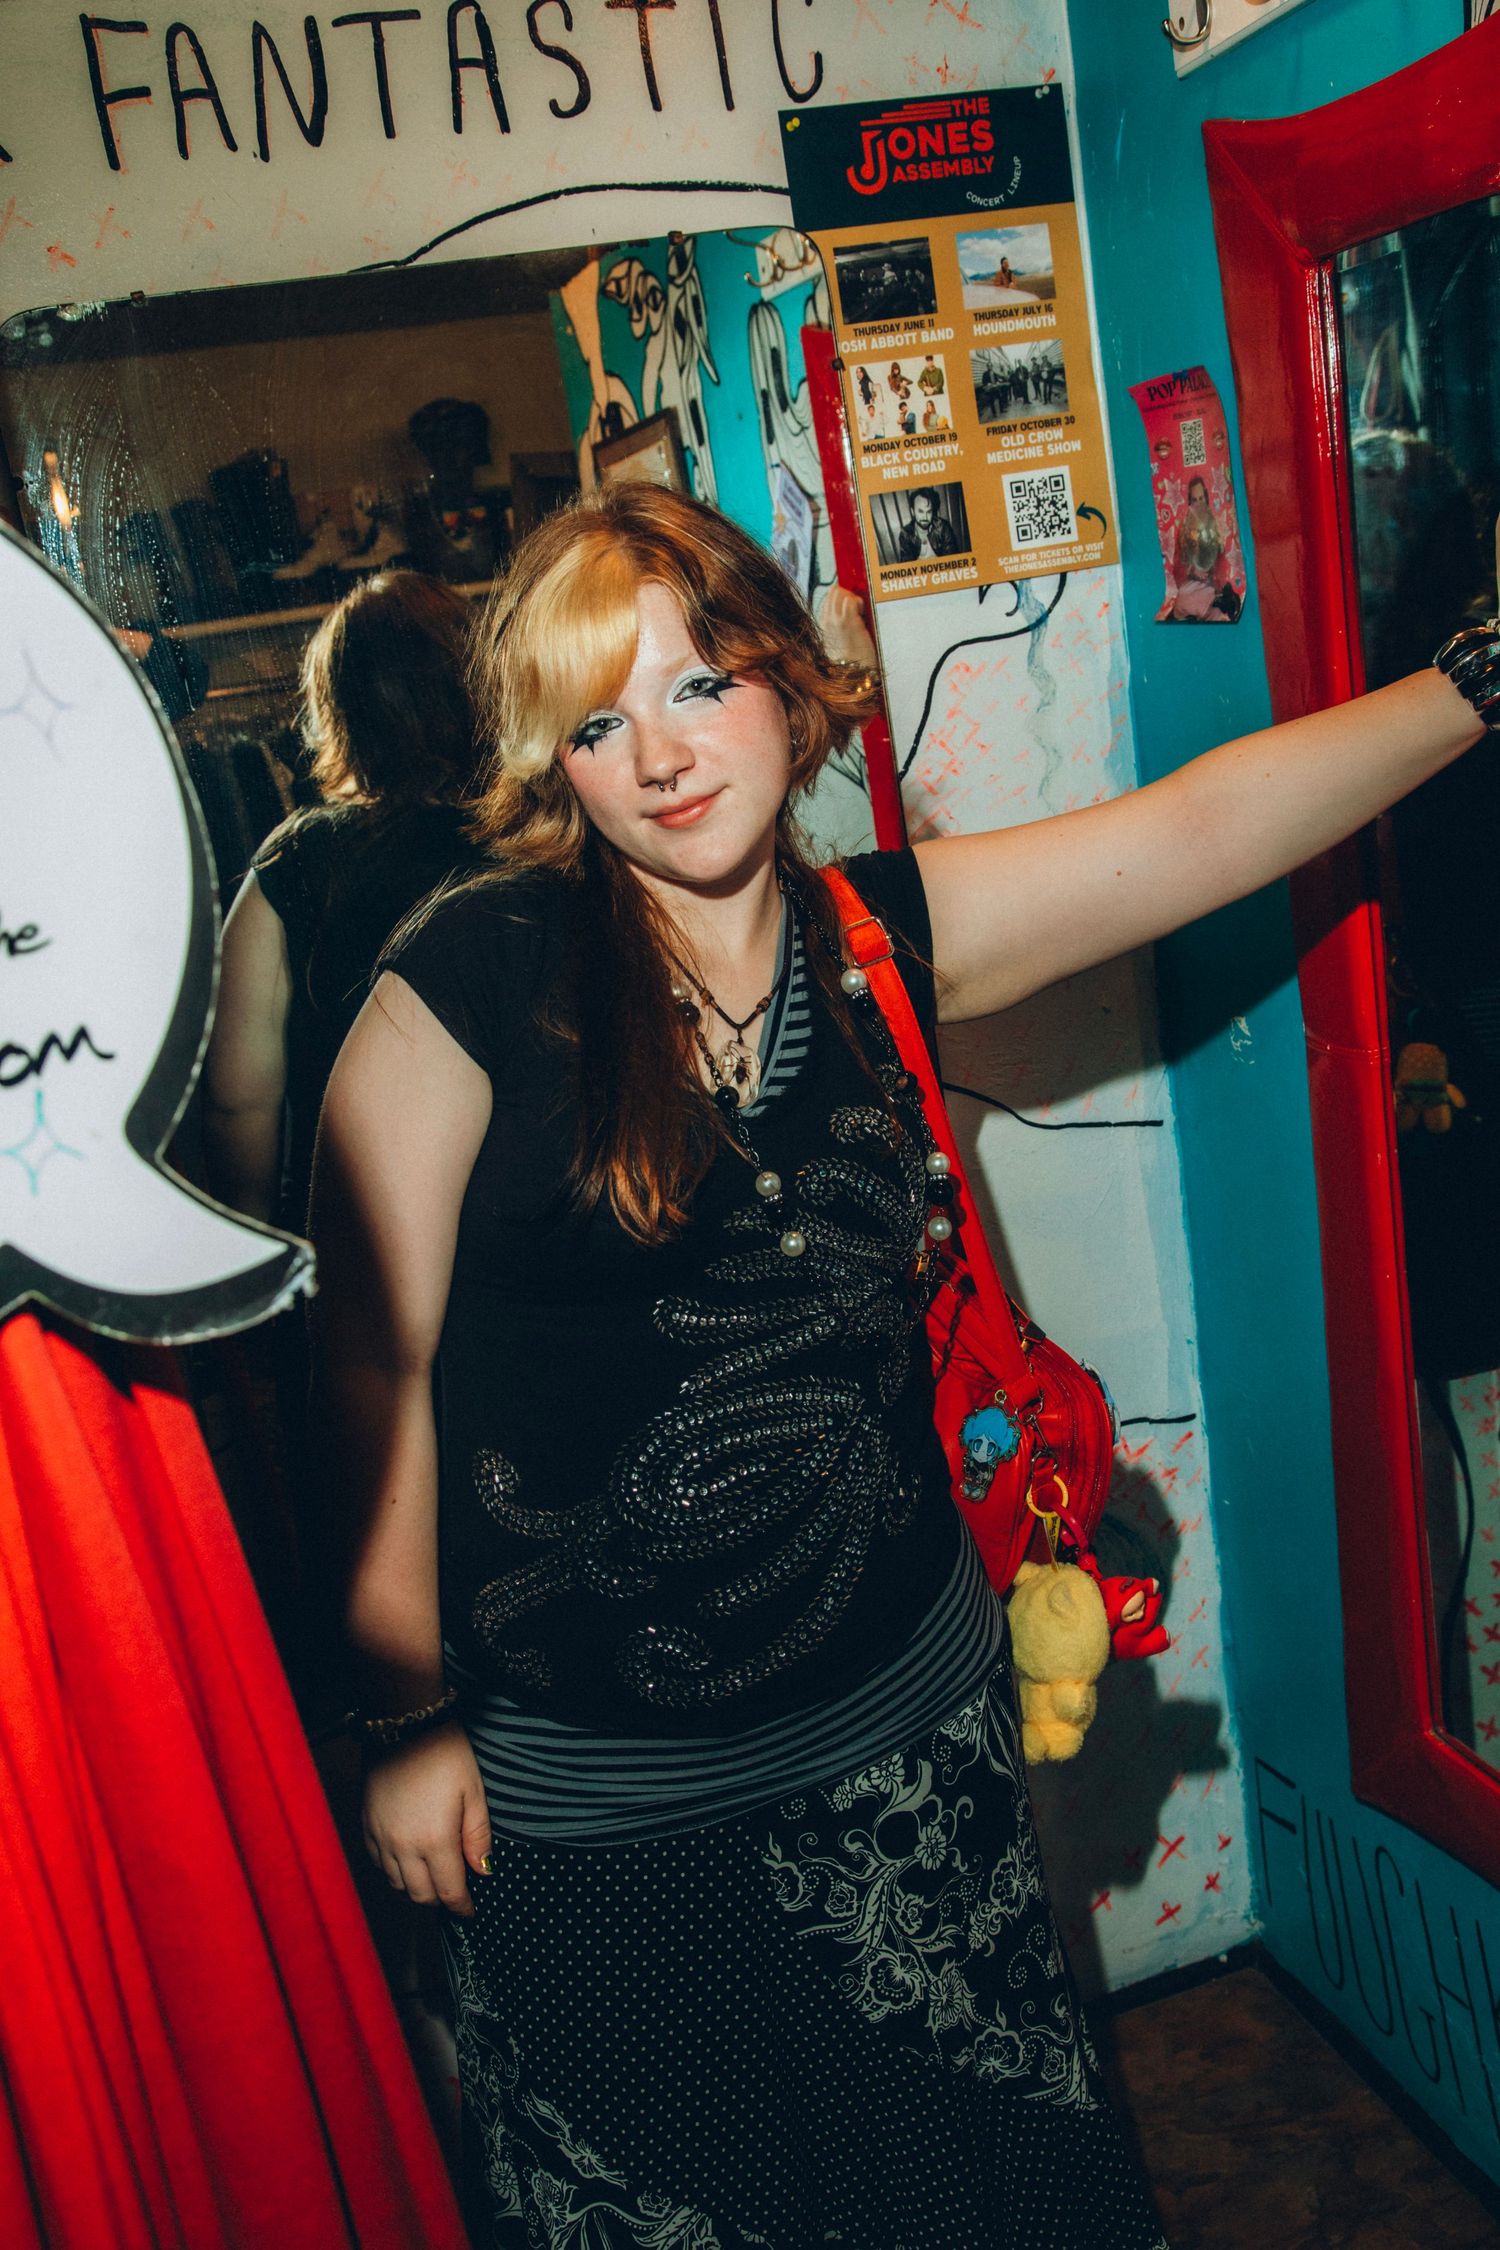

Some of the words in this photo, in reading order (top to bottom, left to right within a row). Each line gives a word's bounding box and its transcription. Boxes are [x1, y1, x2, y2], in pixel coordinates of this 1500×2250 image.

[80, 0, 824, 171] FANTASTIC
[951, 96, 990, 116] THE
[846, 119, 995, 195] JONES
[892, 155, 995, 184] ASSEMBLY
[966, 191, 1005, 207] CONCERT
[1007, 156, 1022, 196] LINEUP
[973, 307, 1020, 321] THURSDAY
[1022, 304, 1042, 315] JULY
[1044, 303, 1054, 313] 16
[853, 323, 901, 337] THURSDAY
[903, 319, 926, 331] JUNE
[928, 318, 935, 328] 11
[972, 314, 1057, 337] HOUNDMOUTH
[838, 338, 867, 353] OSH
[871, 332, 917, 350] ABBOTT
[921, 327, 955, 344] BAND
[1146, 378, 1177, 402] POP
[986, 423, 1018, 436] FRIDAY
[1020, 417, 1063, 431] OCTOBER
[1064, 415, 1076, 425] 30
[1001, 433, 1025, 448] OLD
[1028, 427, 1064, 444] CROW
[863, 440, 901, 454] MONDAY
[903, 433, 946, 448] OCTOBER
[948, 432, 958, 442] 19
[986, 445, 1044, 465] MEDICINE
[1047, 439, 1082, 456] SHOW
[861, 452, 900, 469] BLACK
[903, 443, 964, 462] COUNTRY,
[882, 464, 909, 480] NEW
[912, 459, 946, 475] ROAD
[998, 556, 1019, 567] SCAN
[1020, 553, 1037, 564] FOR
[1038, 546, 1071, 560] TICKETS
[1071, 544, 1084, 554] OR
[1085, 541, 1104, 552] VISIT
[880, 566, 918, 580] MONDAY
[920, 559, 969, 574] NOVEMBER
[971, 557, 977, 566] 2
[881, 574, 928, 593] SHAKEY
[931, 566, 979, 585] GRAVES
